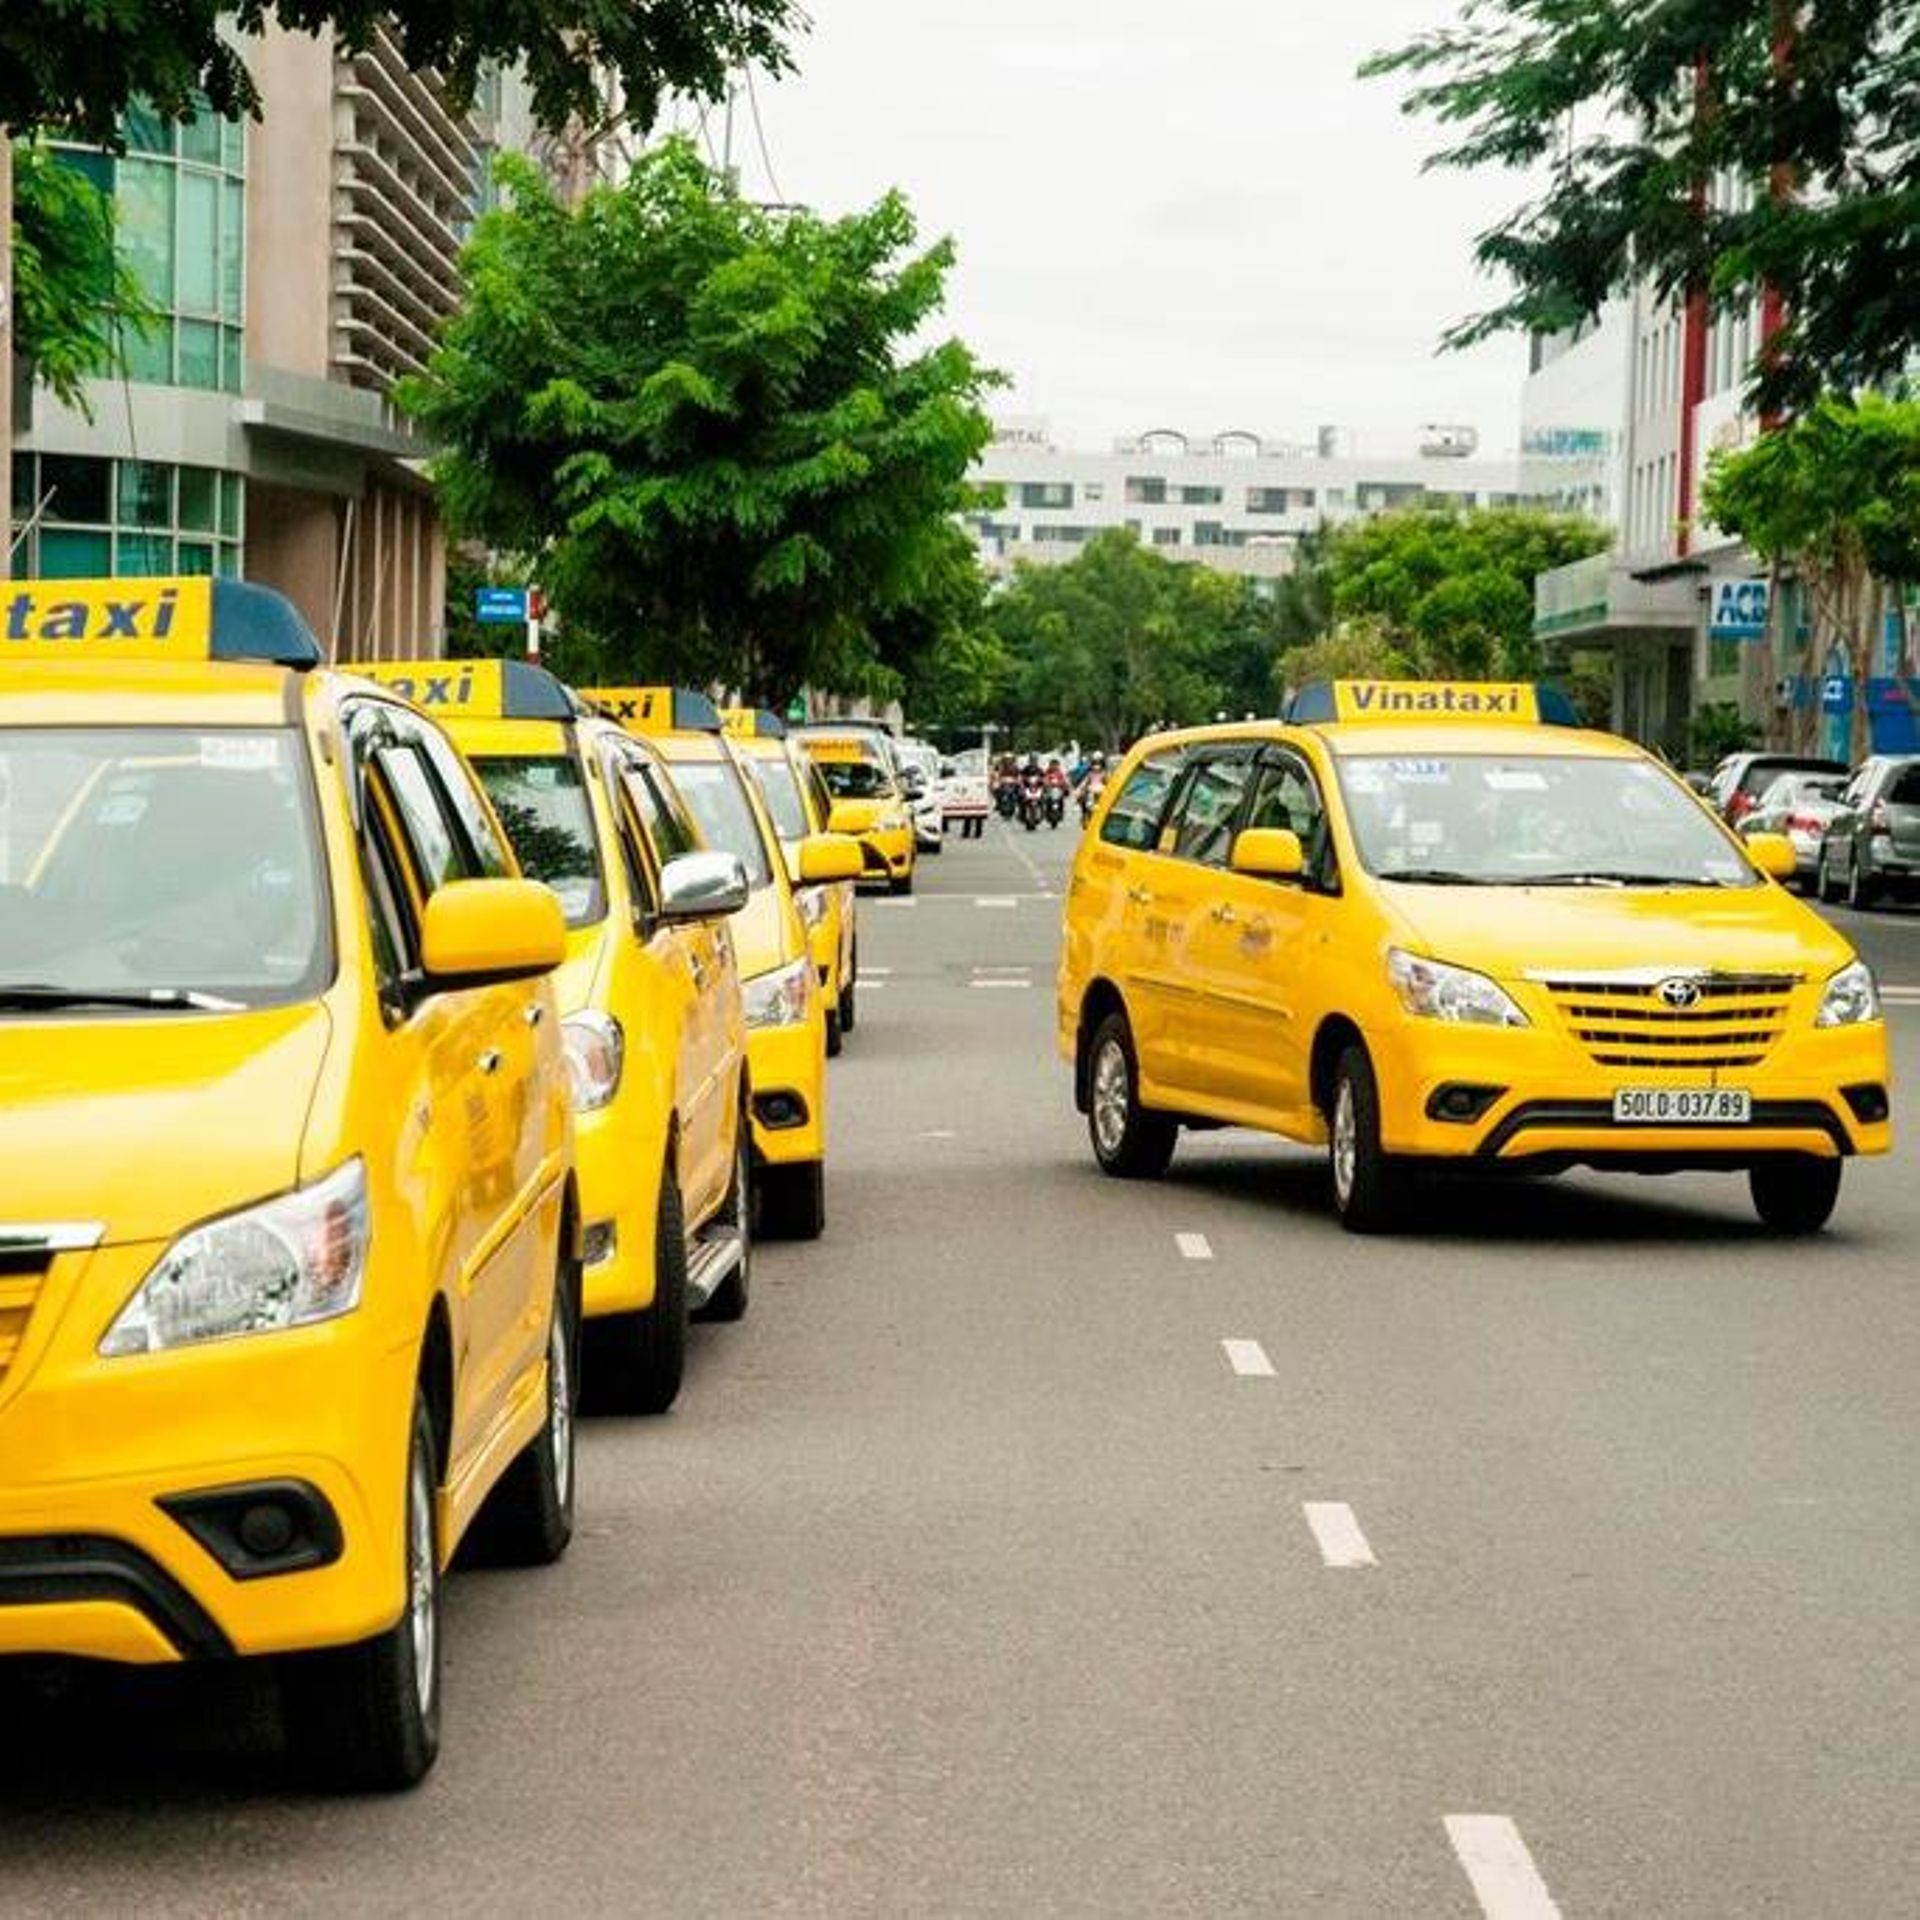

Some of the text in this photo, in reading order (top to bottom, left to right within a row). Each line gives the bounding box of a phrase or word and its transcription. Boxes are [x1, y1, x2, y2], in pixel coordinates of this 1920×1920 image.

[7, 588, 178, 639] taxi
[1716, 584, 1767, 623] ACB
[1352, 685, 1519, 712] Vinataxi
